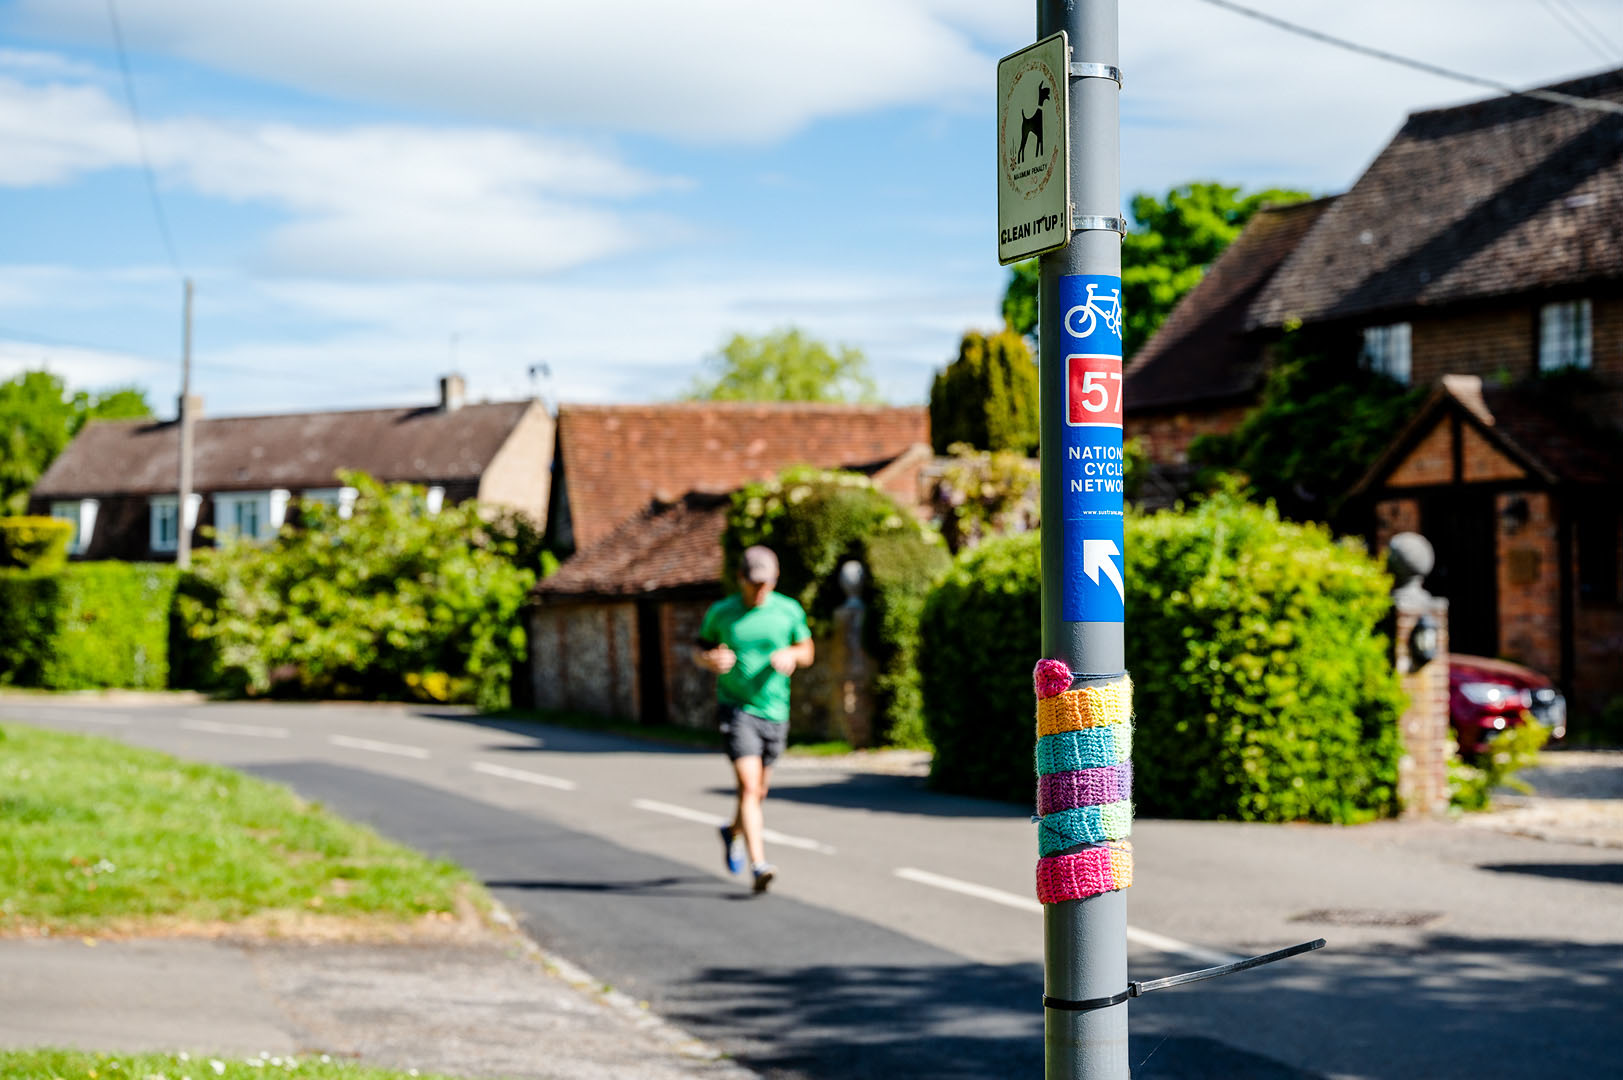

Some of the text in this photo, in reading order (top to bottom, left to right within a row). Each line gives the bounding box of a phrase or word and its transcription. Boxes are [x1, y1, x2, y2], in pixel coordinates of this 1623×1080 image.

[1031, 163, 1048, 175] PENALTY
[1000, 222, 1031, 245] CLEAN
[1033, 218, 1043, 235] IT
[1081, 371, 1123, 413] 57
[1068, 446, 1124, 460] NATION
